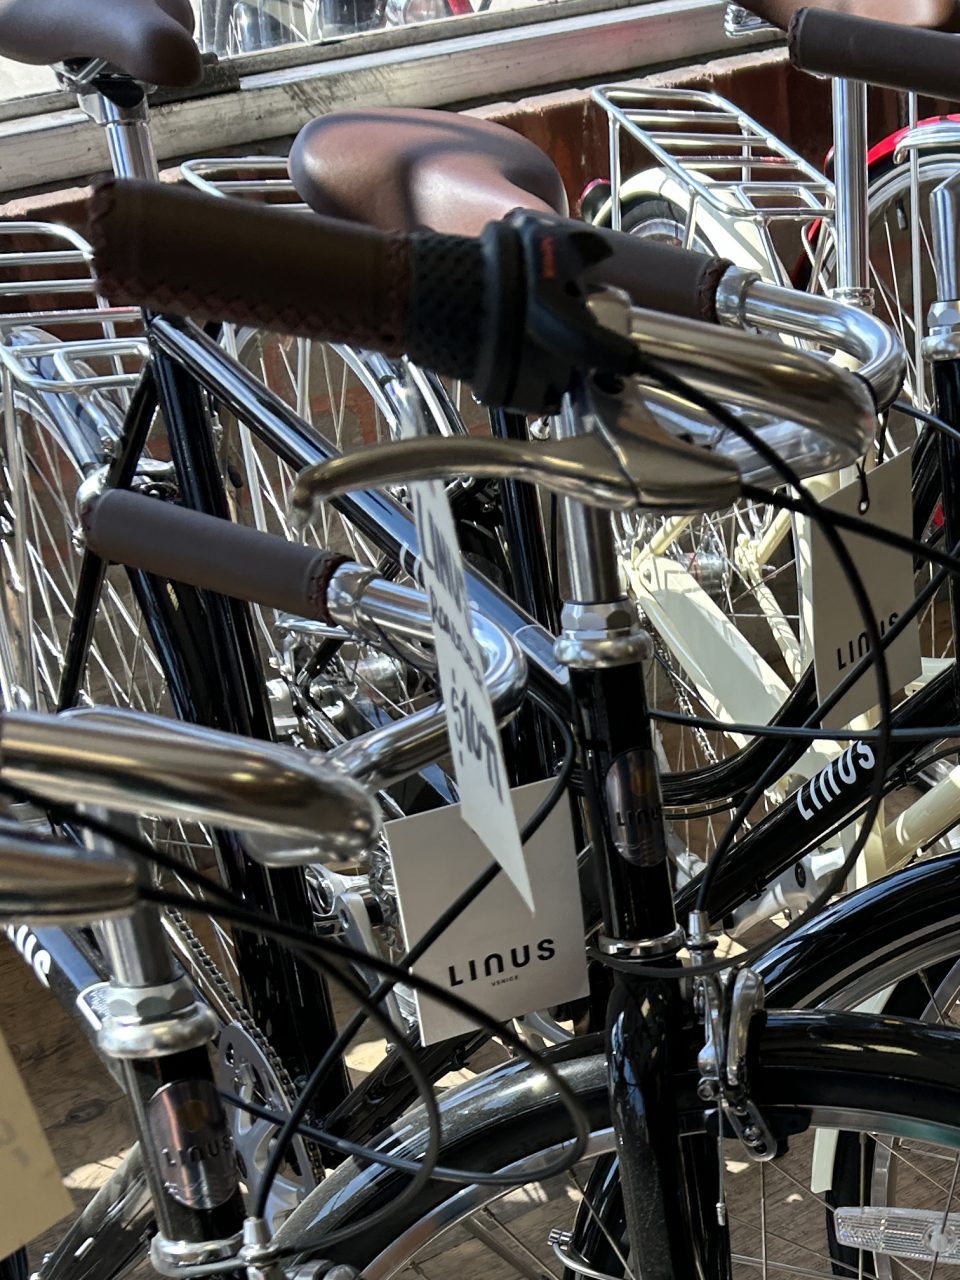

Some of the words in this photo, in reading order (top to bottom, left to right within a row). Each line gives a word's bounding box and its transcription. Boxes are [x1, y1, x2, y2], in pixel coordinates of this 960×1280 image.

[796, 740, 876, 821] LINUS
[448, 938, 556, 987] LINUS
[491, 974, 519, 987] VENICE
